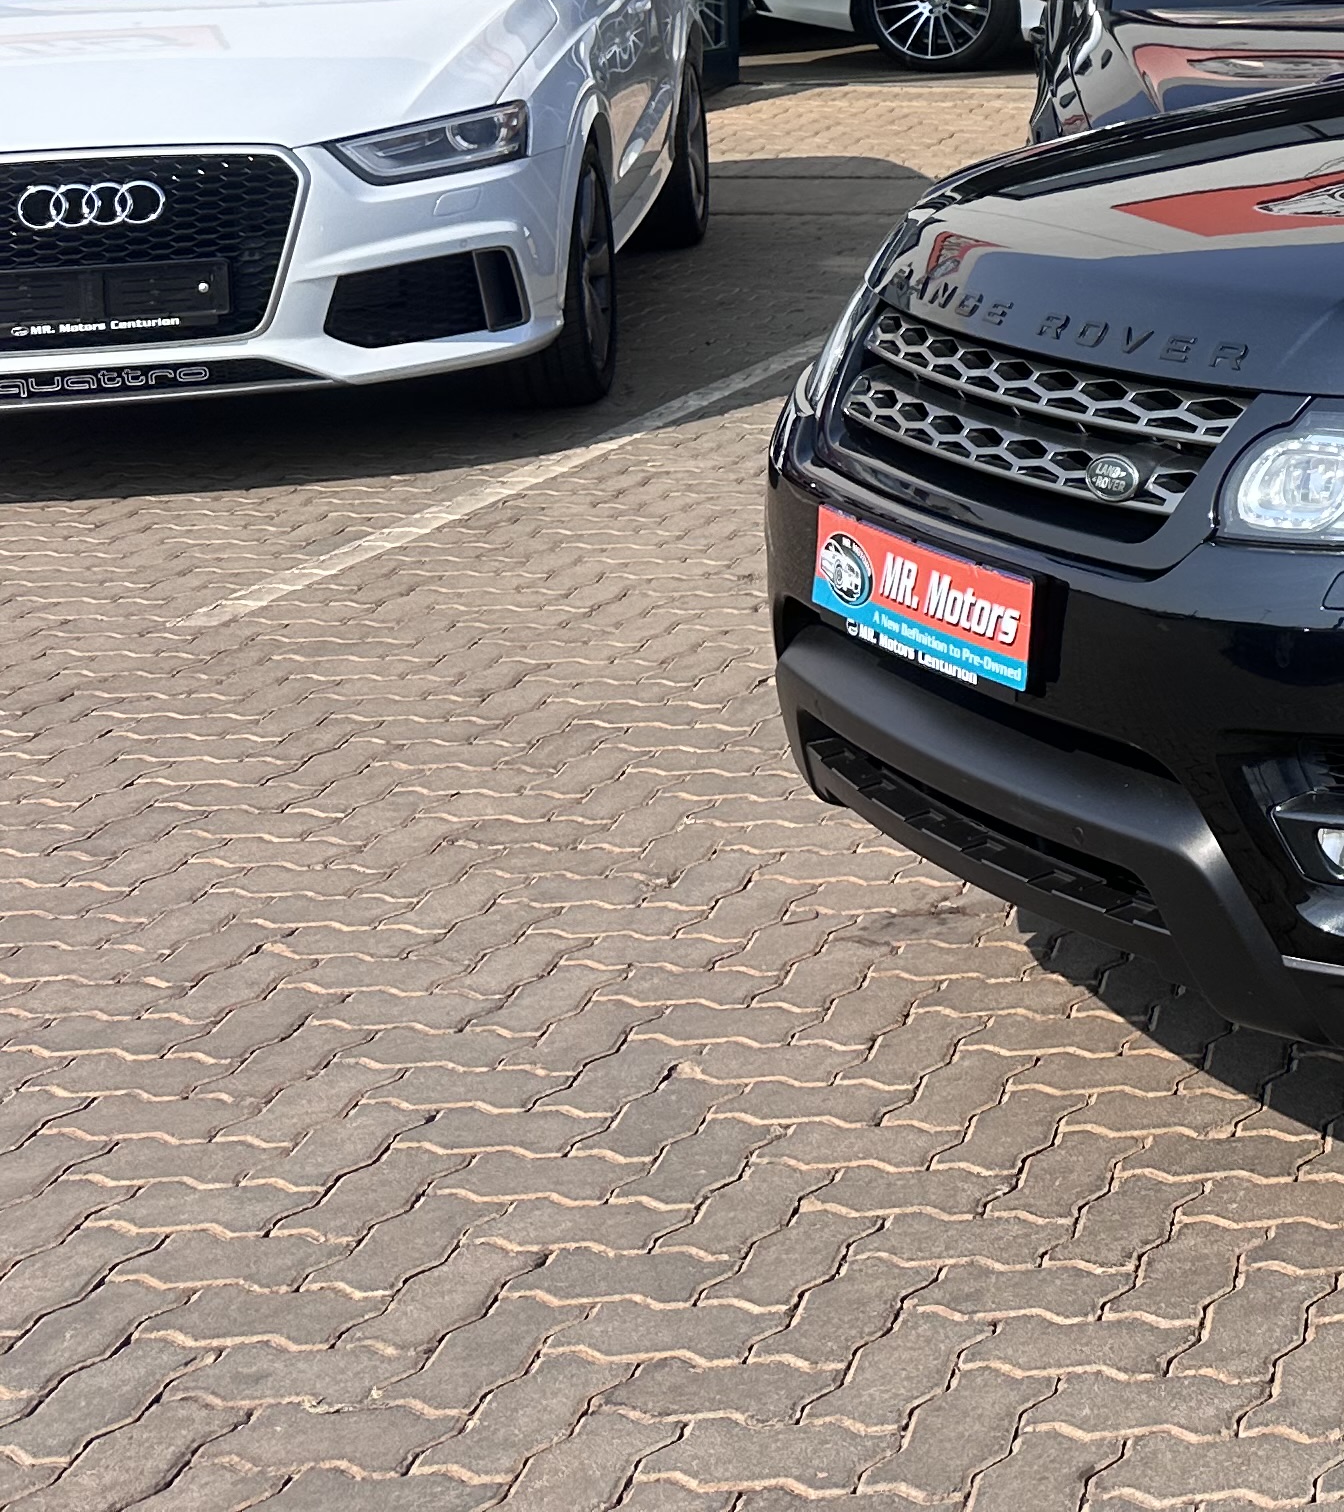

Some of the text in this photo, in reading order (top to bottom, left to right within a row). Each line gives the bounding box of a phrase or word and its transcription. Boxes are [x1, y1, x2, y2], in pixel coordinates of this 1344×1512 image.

[59, 322, 106, 333] Motors
[110, 316, 180, 330] Centurion
[1036, 312, 1250, 371] ROVER
[0, 366, 210, 398] quattro
[879, 551, 1021, 645] MR. Motors
[872, 610, 1022, 682] A New Definition to Pre-Owned
